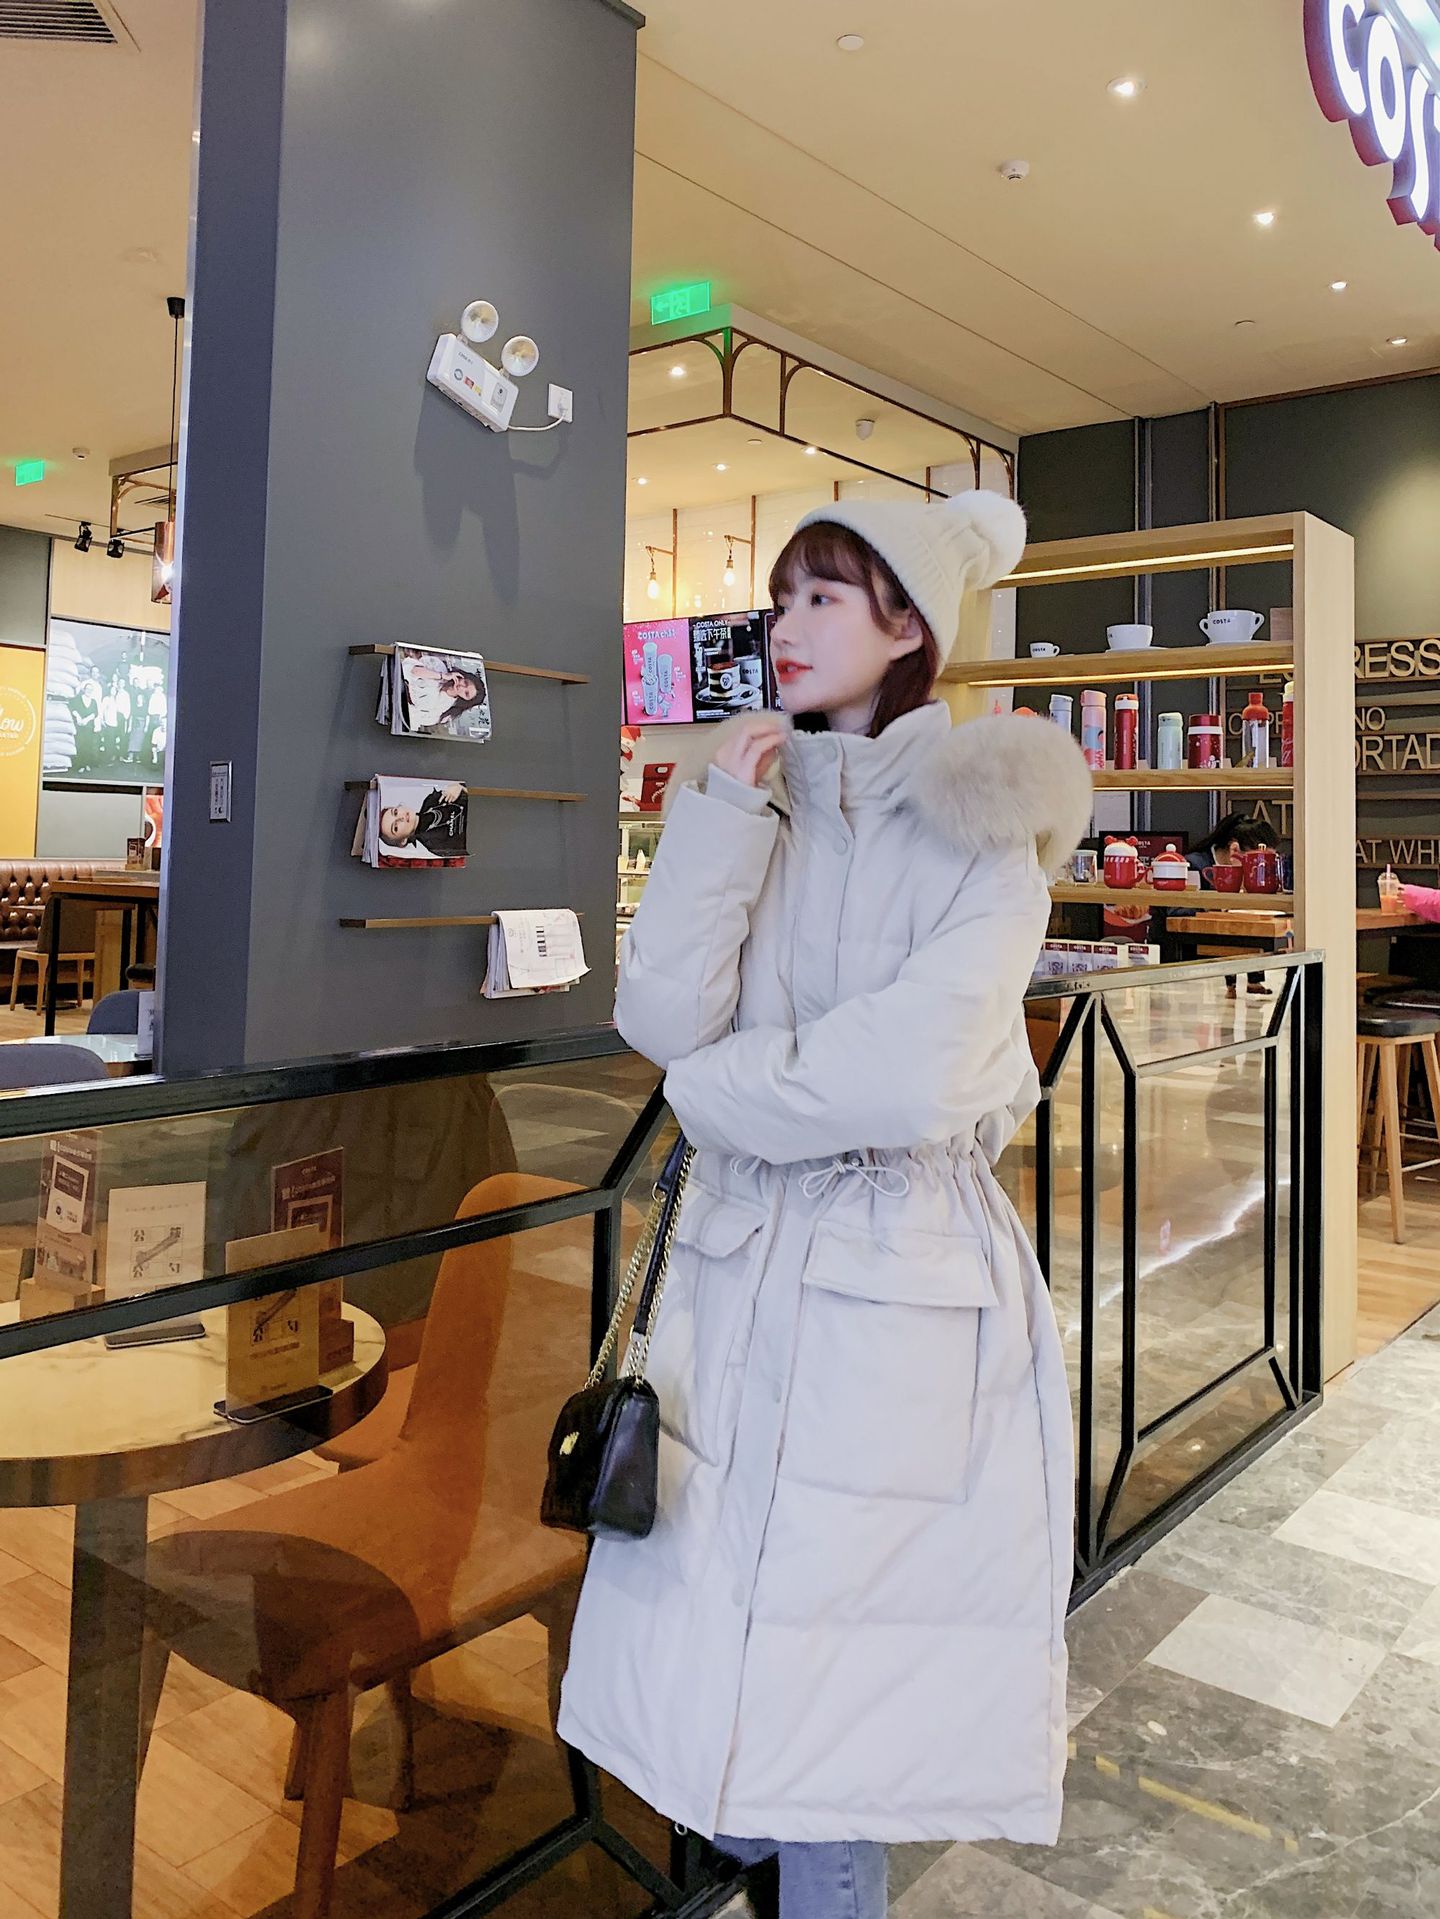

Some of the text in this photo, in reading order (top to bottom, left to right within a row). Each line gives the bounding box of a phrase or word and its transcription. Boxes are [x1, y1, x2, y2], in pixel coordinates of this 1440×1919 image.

[696, 620, 714, 628] COSTA
[637, 631, 660, 640] COSTA
[1355, 733, 1440, 771] RTAD
